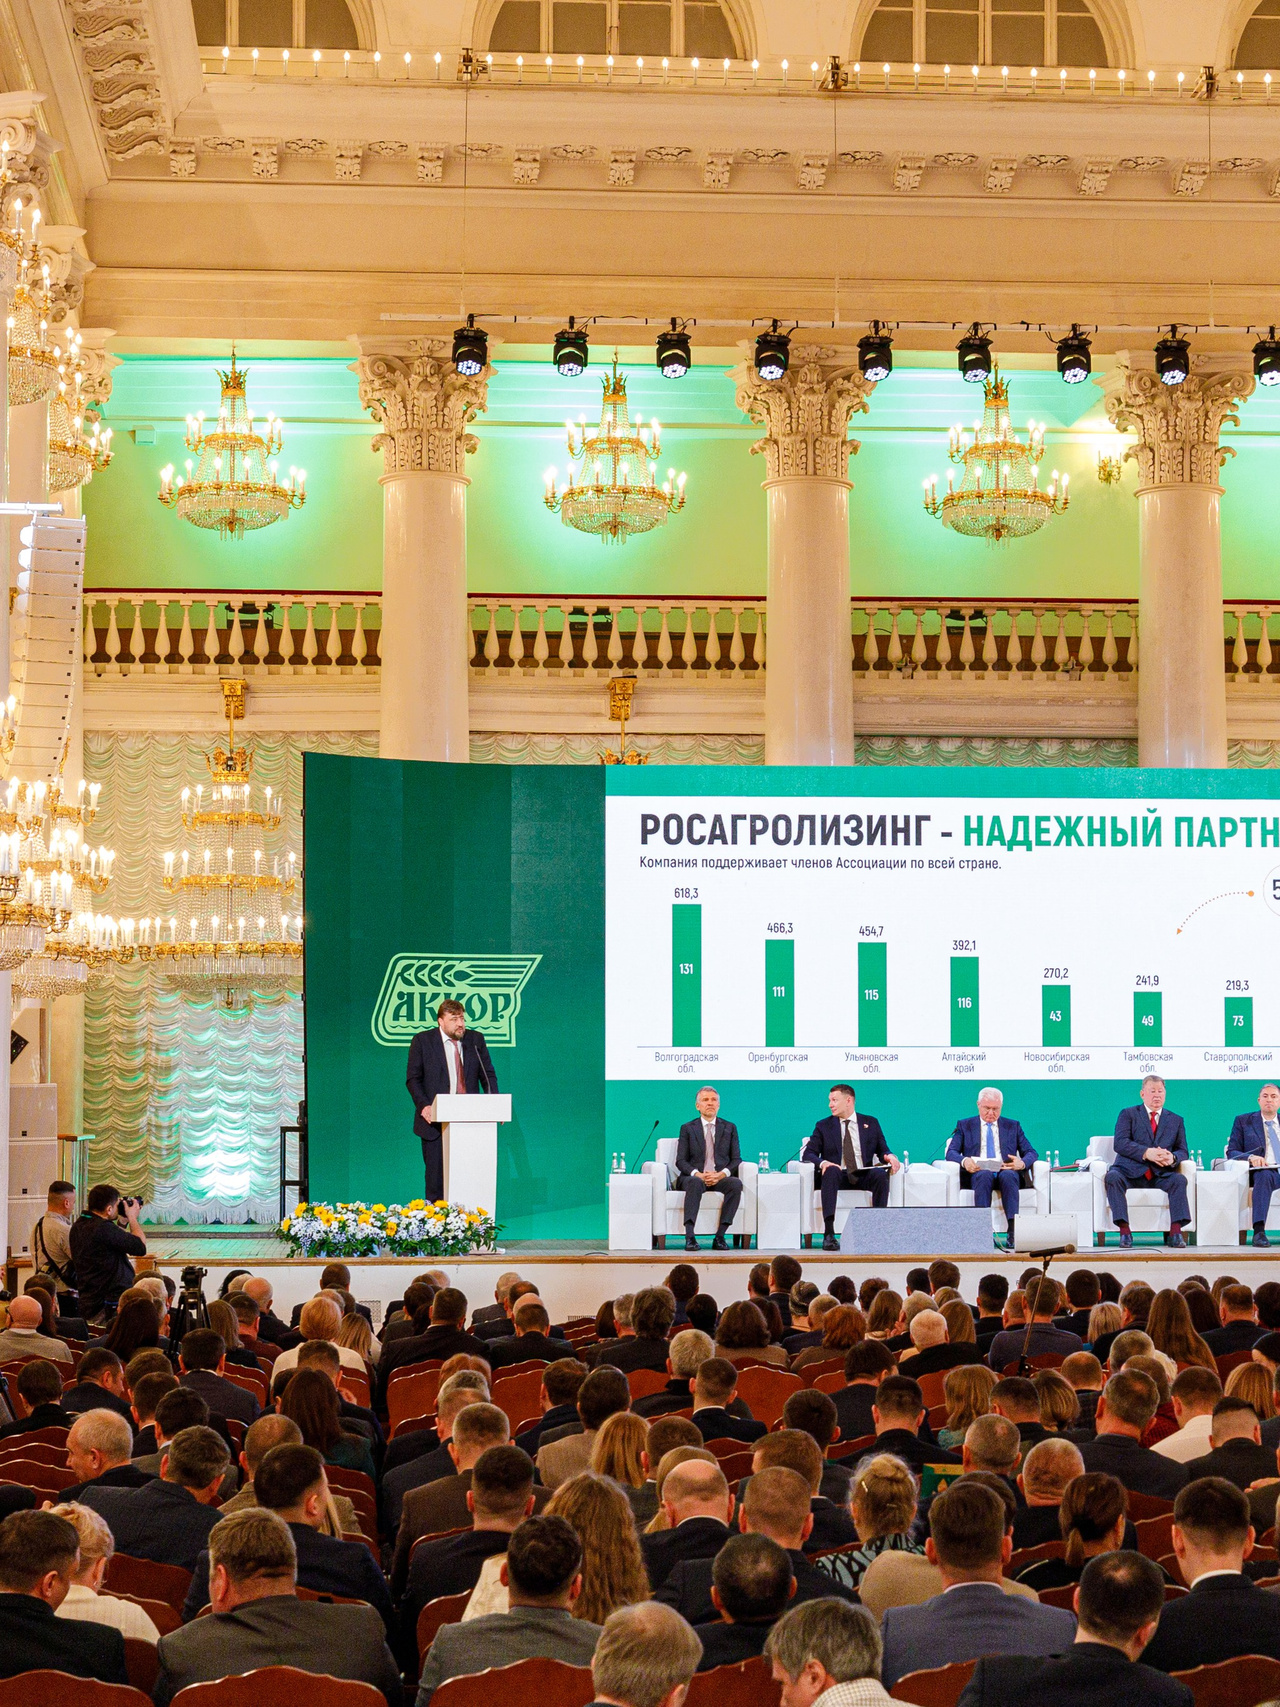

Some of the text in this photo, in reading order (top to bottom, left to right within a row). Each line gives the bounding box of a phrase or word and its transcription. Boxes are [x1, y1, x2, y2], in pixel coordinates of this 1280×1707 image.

[641, 814, 930, 846] РОСАГРОЛИЗИНГ
[964, 808, 1161, 851] НАДЕЖНЫЙ
[640, 856, 1001, 871] Компания поддерживает членов Ассоциации по всей стране.
[675, 888, 698, 899] 618,3
[767, 923, 793, 933] 466,3
[859, 926, 883, 937] 454,7
[953, 940, 975, 951] 392,1
[680, 964, 693, 974] 131
[1044, 968, 1068, 979] 270,2
[1136, 975, 1159, 986] 241,9
[1226, 980, 1249, 991] 219,3
[773, 986, 785, 997] 111
[865, 990, 879, 1000] 115
[958, 997, 971, 1008] 116
[1050, 1011, 1061, 1021] 43
[1142, 1015, 1153, 1026] 49
[1233, 1016, 1243, 1026] 73
[654, 1052, 719, 1061] Волгоградская
[748, 1052, 809, 1063] Оренбургская
[844, 1053, 899, 1061] Ульяновская
[941, 1053, 987, 1061] Алтайский
[1024, 1052, 1090, 1061] Новосибирская
[1123, 1052, 1174, 1061] Тамбовская
[1203, 1052, 1273, 1062] Ставропольский
[677, 1063, 696, 1073] обл.
[769, 1063, 788, 1073] обл.
[862, 1063, 881, 1073] обл.
[954, 1064, 975, 1072] край
[1047, 1063, 1066, 1072] обл.
[1139, 1063, 1157, 1072] обл.
[1228, 1064, 1249, 1073] край
